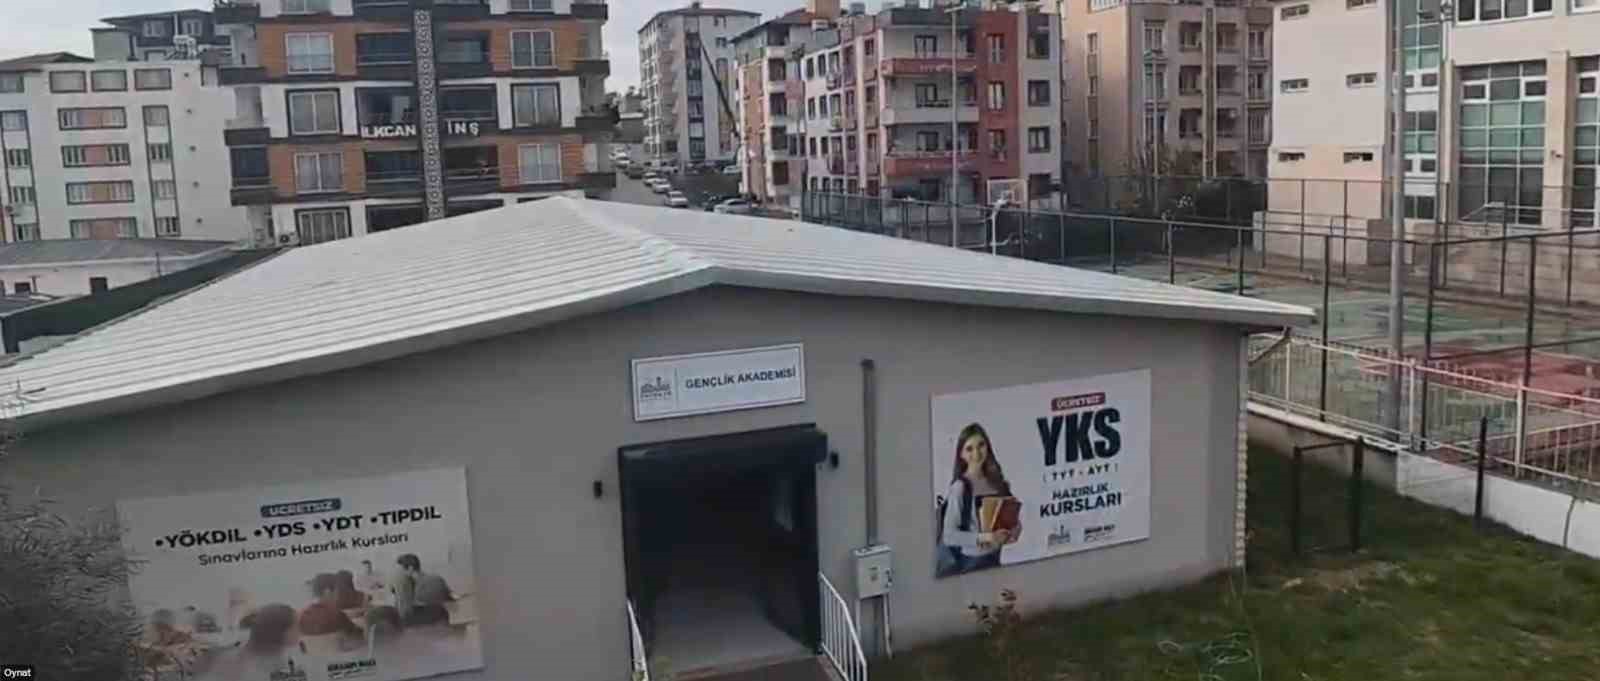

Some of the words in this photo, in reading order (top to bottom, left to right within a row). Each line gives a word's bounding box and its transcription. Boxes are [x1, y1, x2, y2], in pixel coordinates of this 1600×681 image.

[685, 372, 735, 389] GENÇLİK
[738, 365, 797, 384] AKADEMİSİ
[1037, 407, 1121, 466] YKS
[1052, 482, 1109, 500] HAZIRLIK
[1040, 492, 1122, 518] KURSLARI
[291, 538, 347, 555] Hazırlık
[352, 532, 409, 548] Kursları
